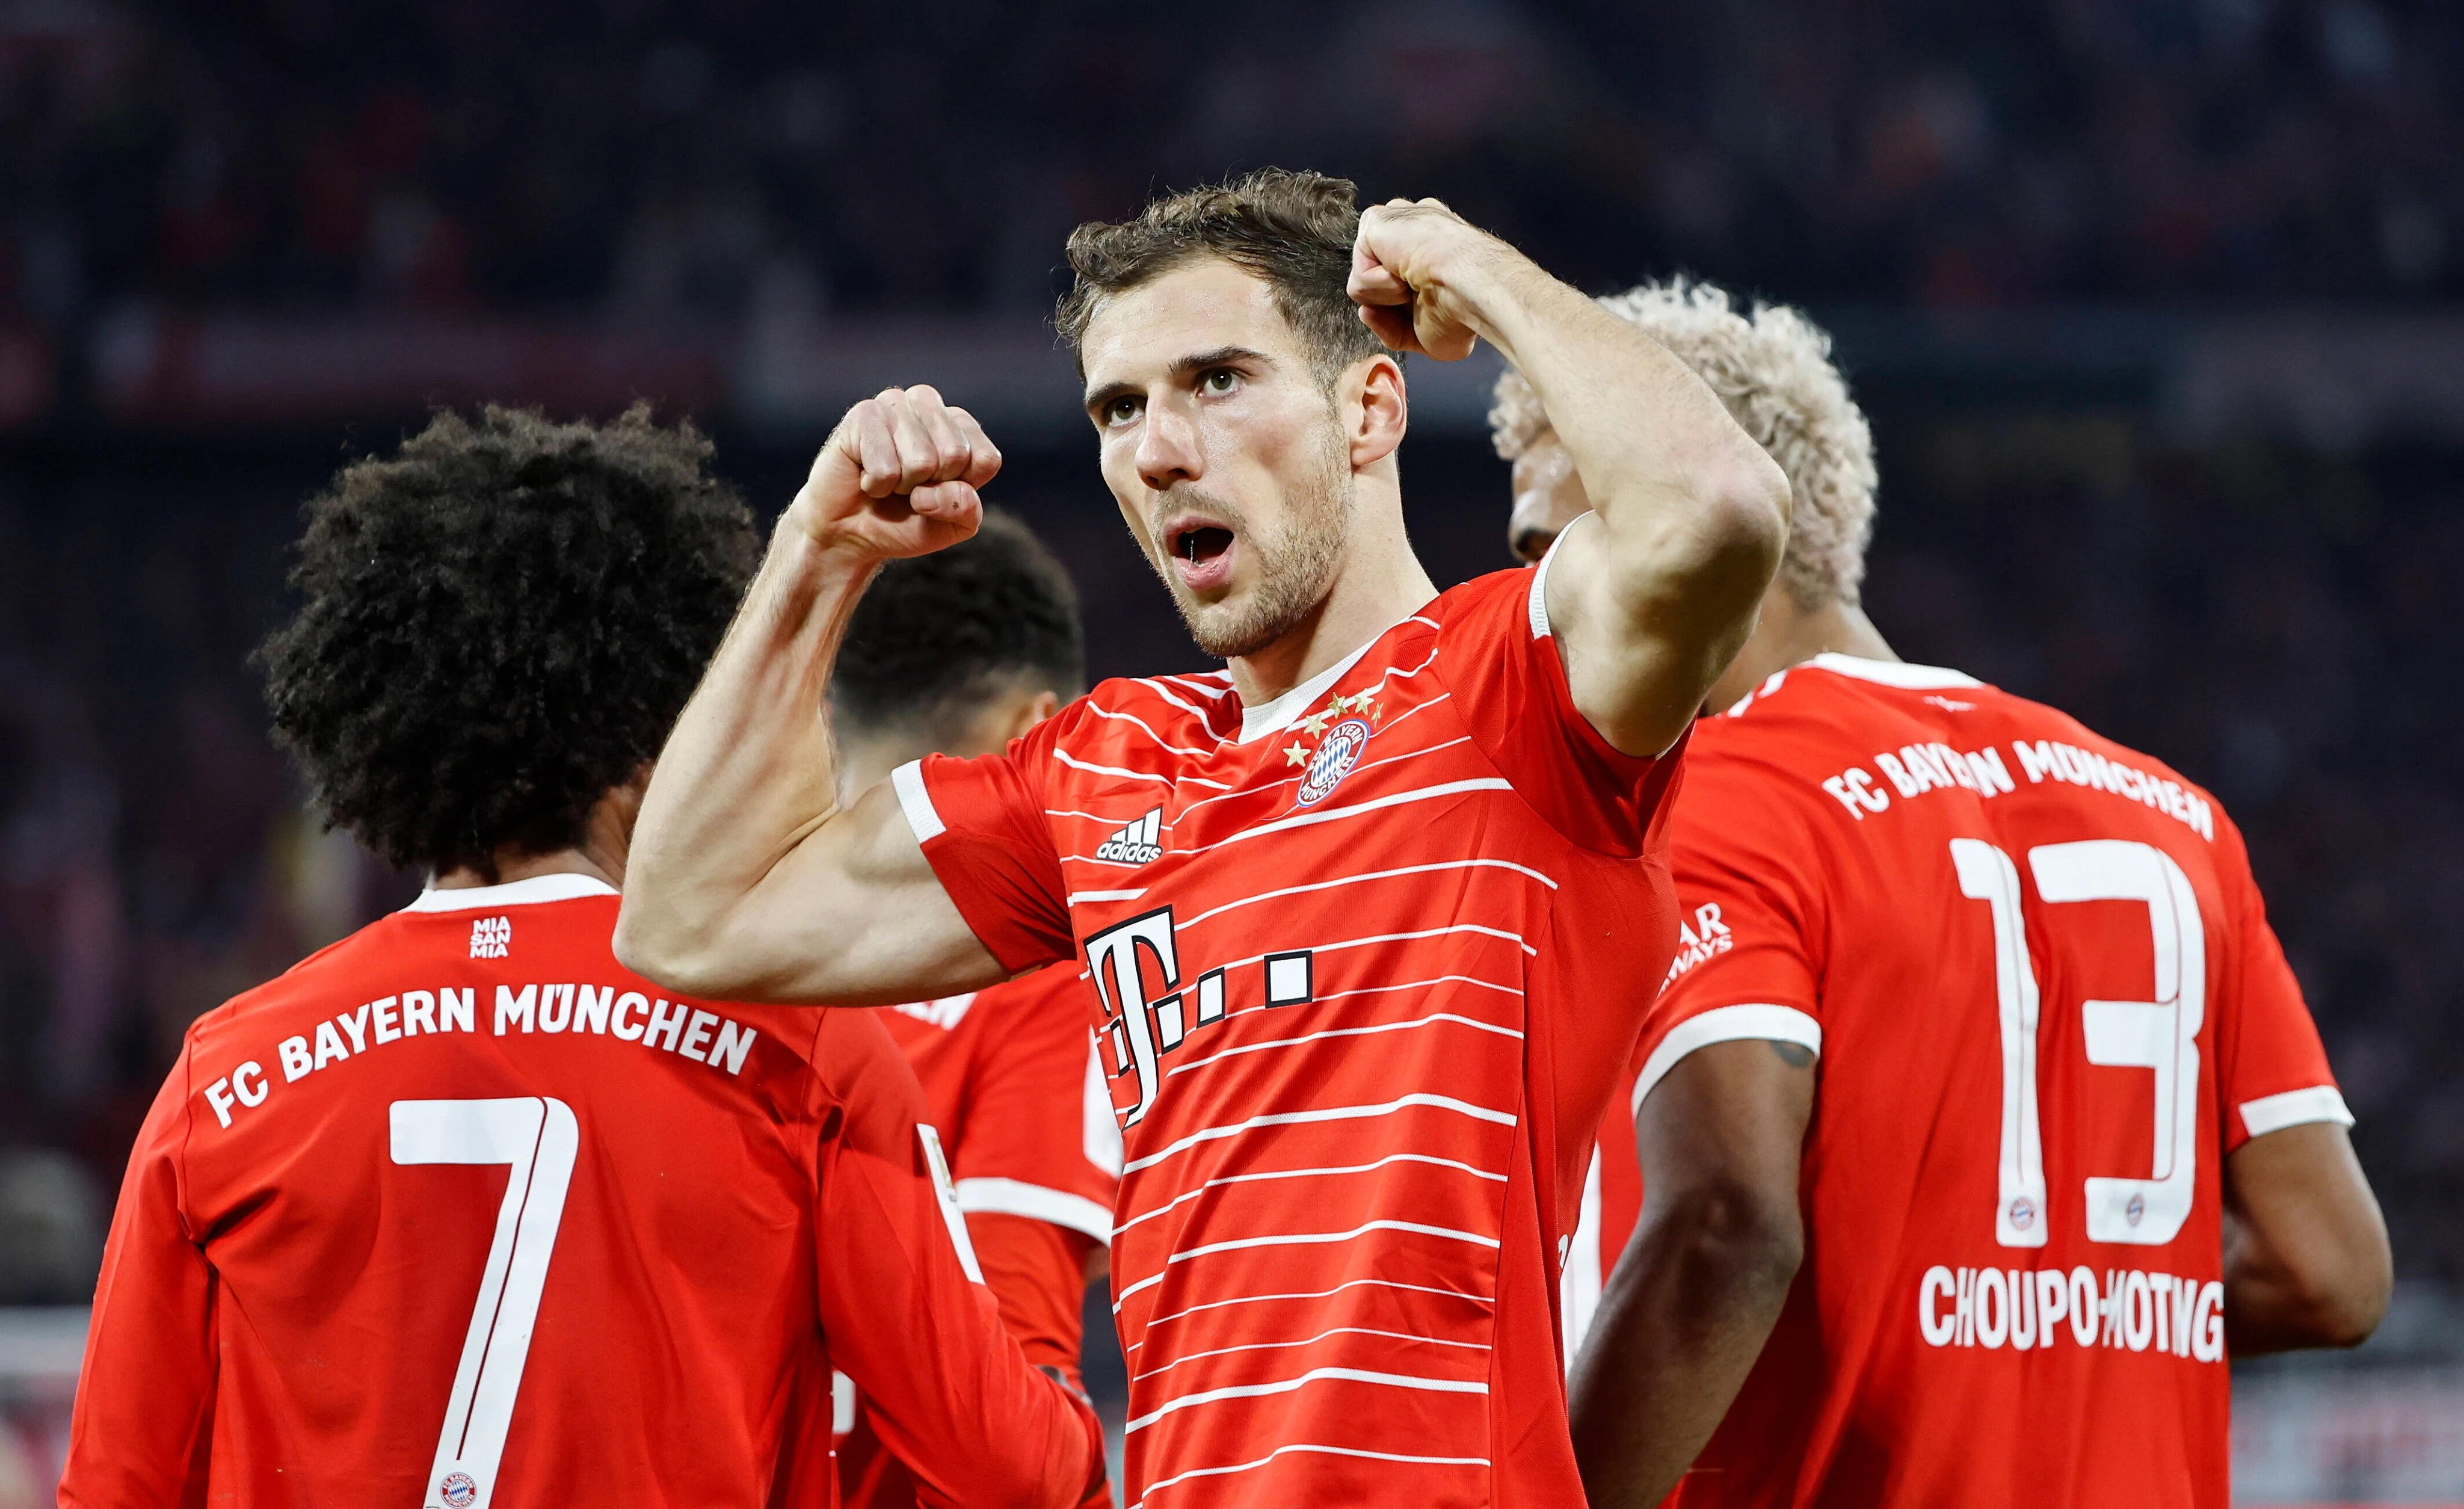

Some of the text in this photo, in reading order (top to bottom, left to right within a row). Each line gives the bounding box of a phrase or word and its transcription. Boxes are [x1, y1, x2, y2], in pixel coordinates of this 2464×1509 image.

[1324, 724, 1363, 748] BAYERN
[1822, 768, 1890, 821] FC
[1873, 741, 2016, 798] BAYEN
[1095, 841, 1162, 863] adidas
[473, 916, 511, 934] MIA
[469, 931, 511, 946] SAN
[469, 943, 509, 958] MIA
[1949, 838, 2205, 1248] 13
[204, 983, 757, 1129] FC BAYERN MÜNCHEN
[389, 1096, 579, 1509] 7
